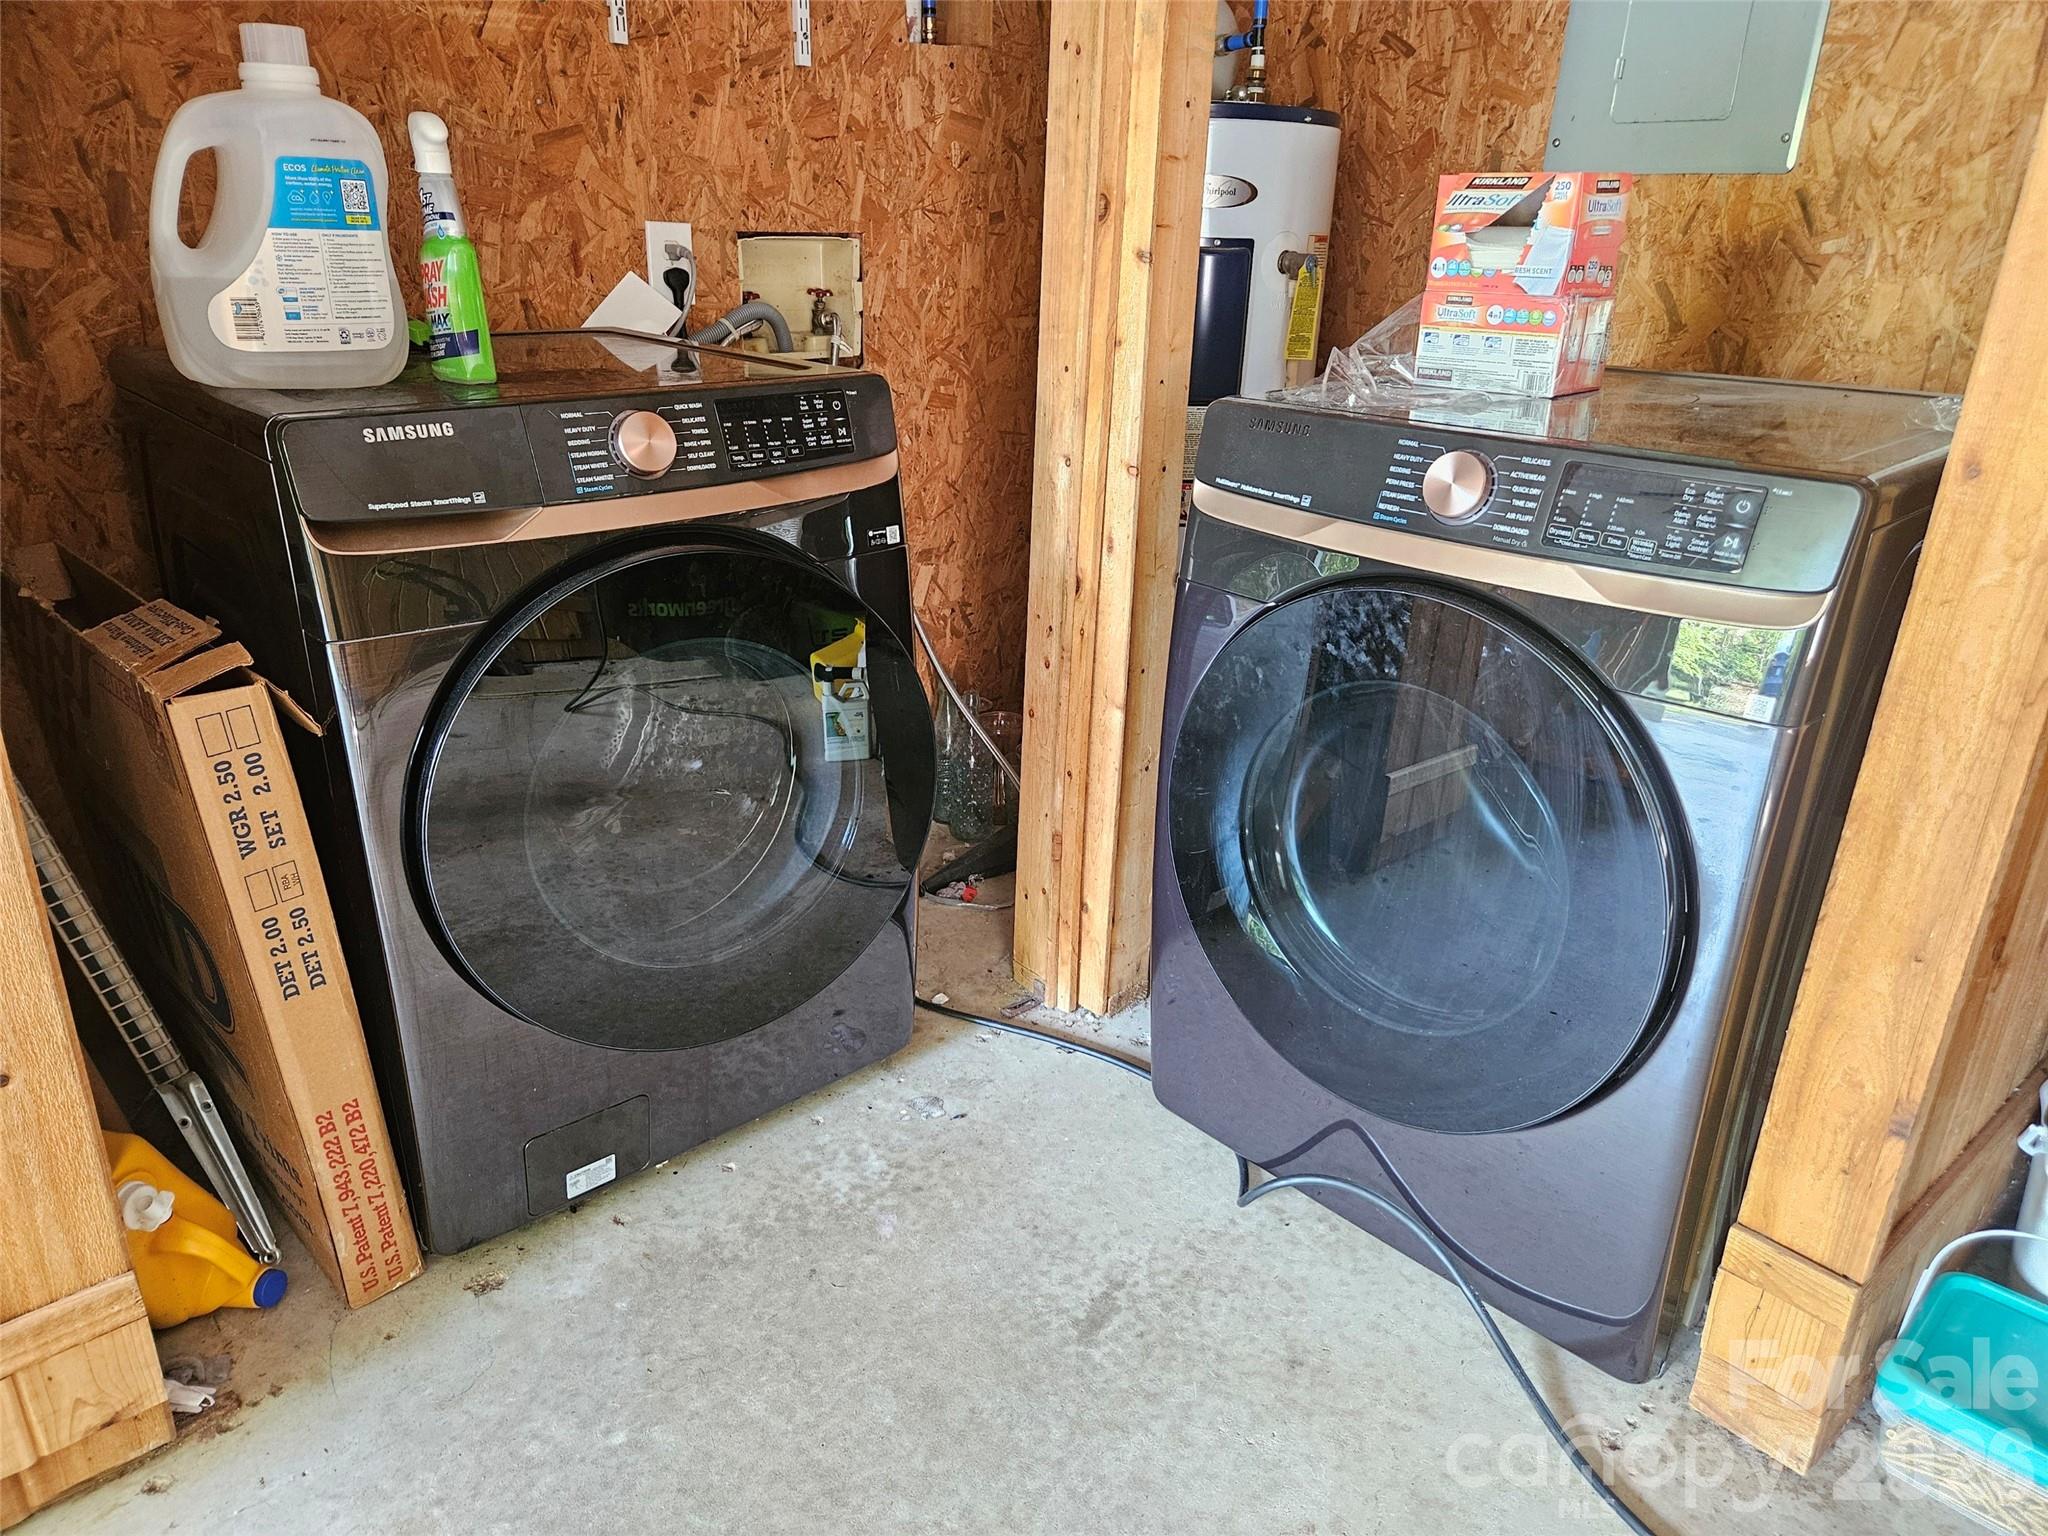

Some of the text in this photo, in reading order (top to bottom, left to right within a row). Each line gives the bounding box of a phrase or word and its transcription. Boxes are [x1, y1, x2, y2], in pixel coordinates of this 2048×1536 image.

[283, 164, 306, 172] ECOS
[1472, 177, 1529, 185] KIRKLAND
[1555, 181, 1572, 190] 250
[1206, 188, 1237, 197] hirlpool
[1588, 199, 1621, 212] UltraSoft
[419, 260, 444, 284] PRAY
[426, 286, 448, 309] ASH
[1437, 308, 1476, 319] UltraSoft
[682, 416, 706, 424] DELICATES
[1248, 417, 1312, 437] SAMSUNG
[362, 422, 454, 443] SAMSUNG
[1398, 439, 1419, 448] NORMAL
[1521, 456, 1551, 467] DELICATES
[1389, 466, 1411, 474] BEDDING
[1510, 472, 1546, 482] ACTIVEWEAR
[1512, 485, 1530, 494] QUICK
[1705, 491, 1725, 500] Adjust
[433, 497, 471, 505] SmartThings
[1511, 499, 1524, 507] TIME
[1378, 503, 1400, 512] REFRESH
[1674, 511, 1691, 519] Damp
[1697, 514, 1716, 522] Adjust
[1492, 524, 1529, 536] DOWNLOADED
[1550, 528, 1571, 537] Dryness
[1493, 535, 1521, 546] Manual Dry
[1578, 532, 1595, 541] Temp.
[1607, 537, 1622, 545] Time
[1691, 538, 1709, 546] Smart
[1687, 545, 1709, 553] Control
[243, 752, 287, 850] SET 2.00
[213, 760, 257, 860] WGR 2.50
[289, 907, 326, 990] DET 2.50
[262, 917, 300, 1001] DET 2.00
[342, 1098, 363, 1126] B2
[315, 1110, 336, 1138] B2
[373, 1201, 397, 1254] Patent
[348, 1213, 373, 1265] Patent
[385, 1250, 404, 1281] U.S.
[360, 1261, 379, 1292] U.S.
